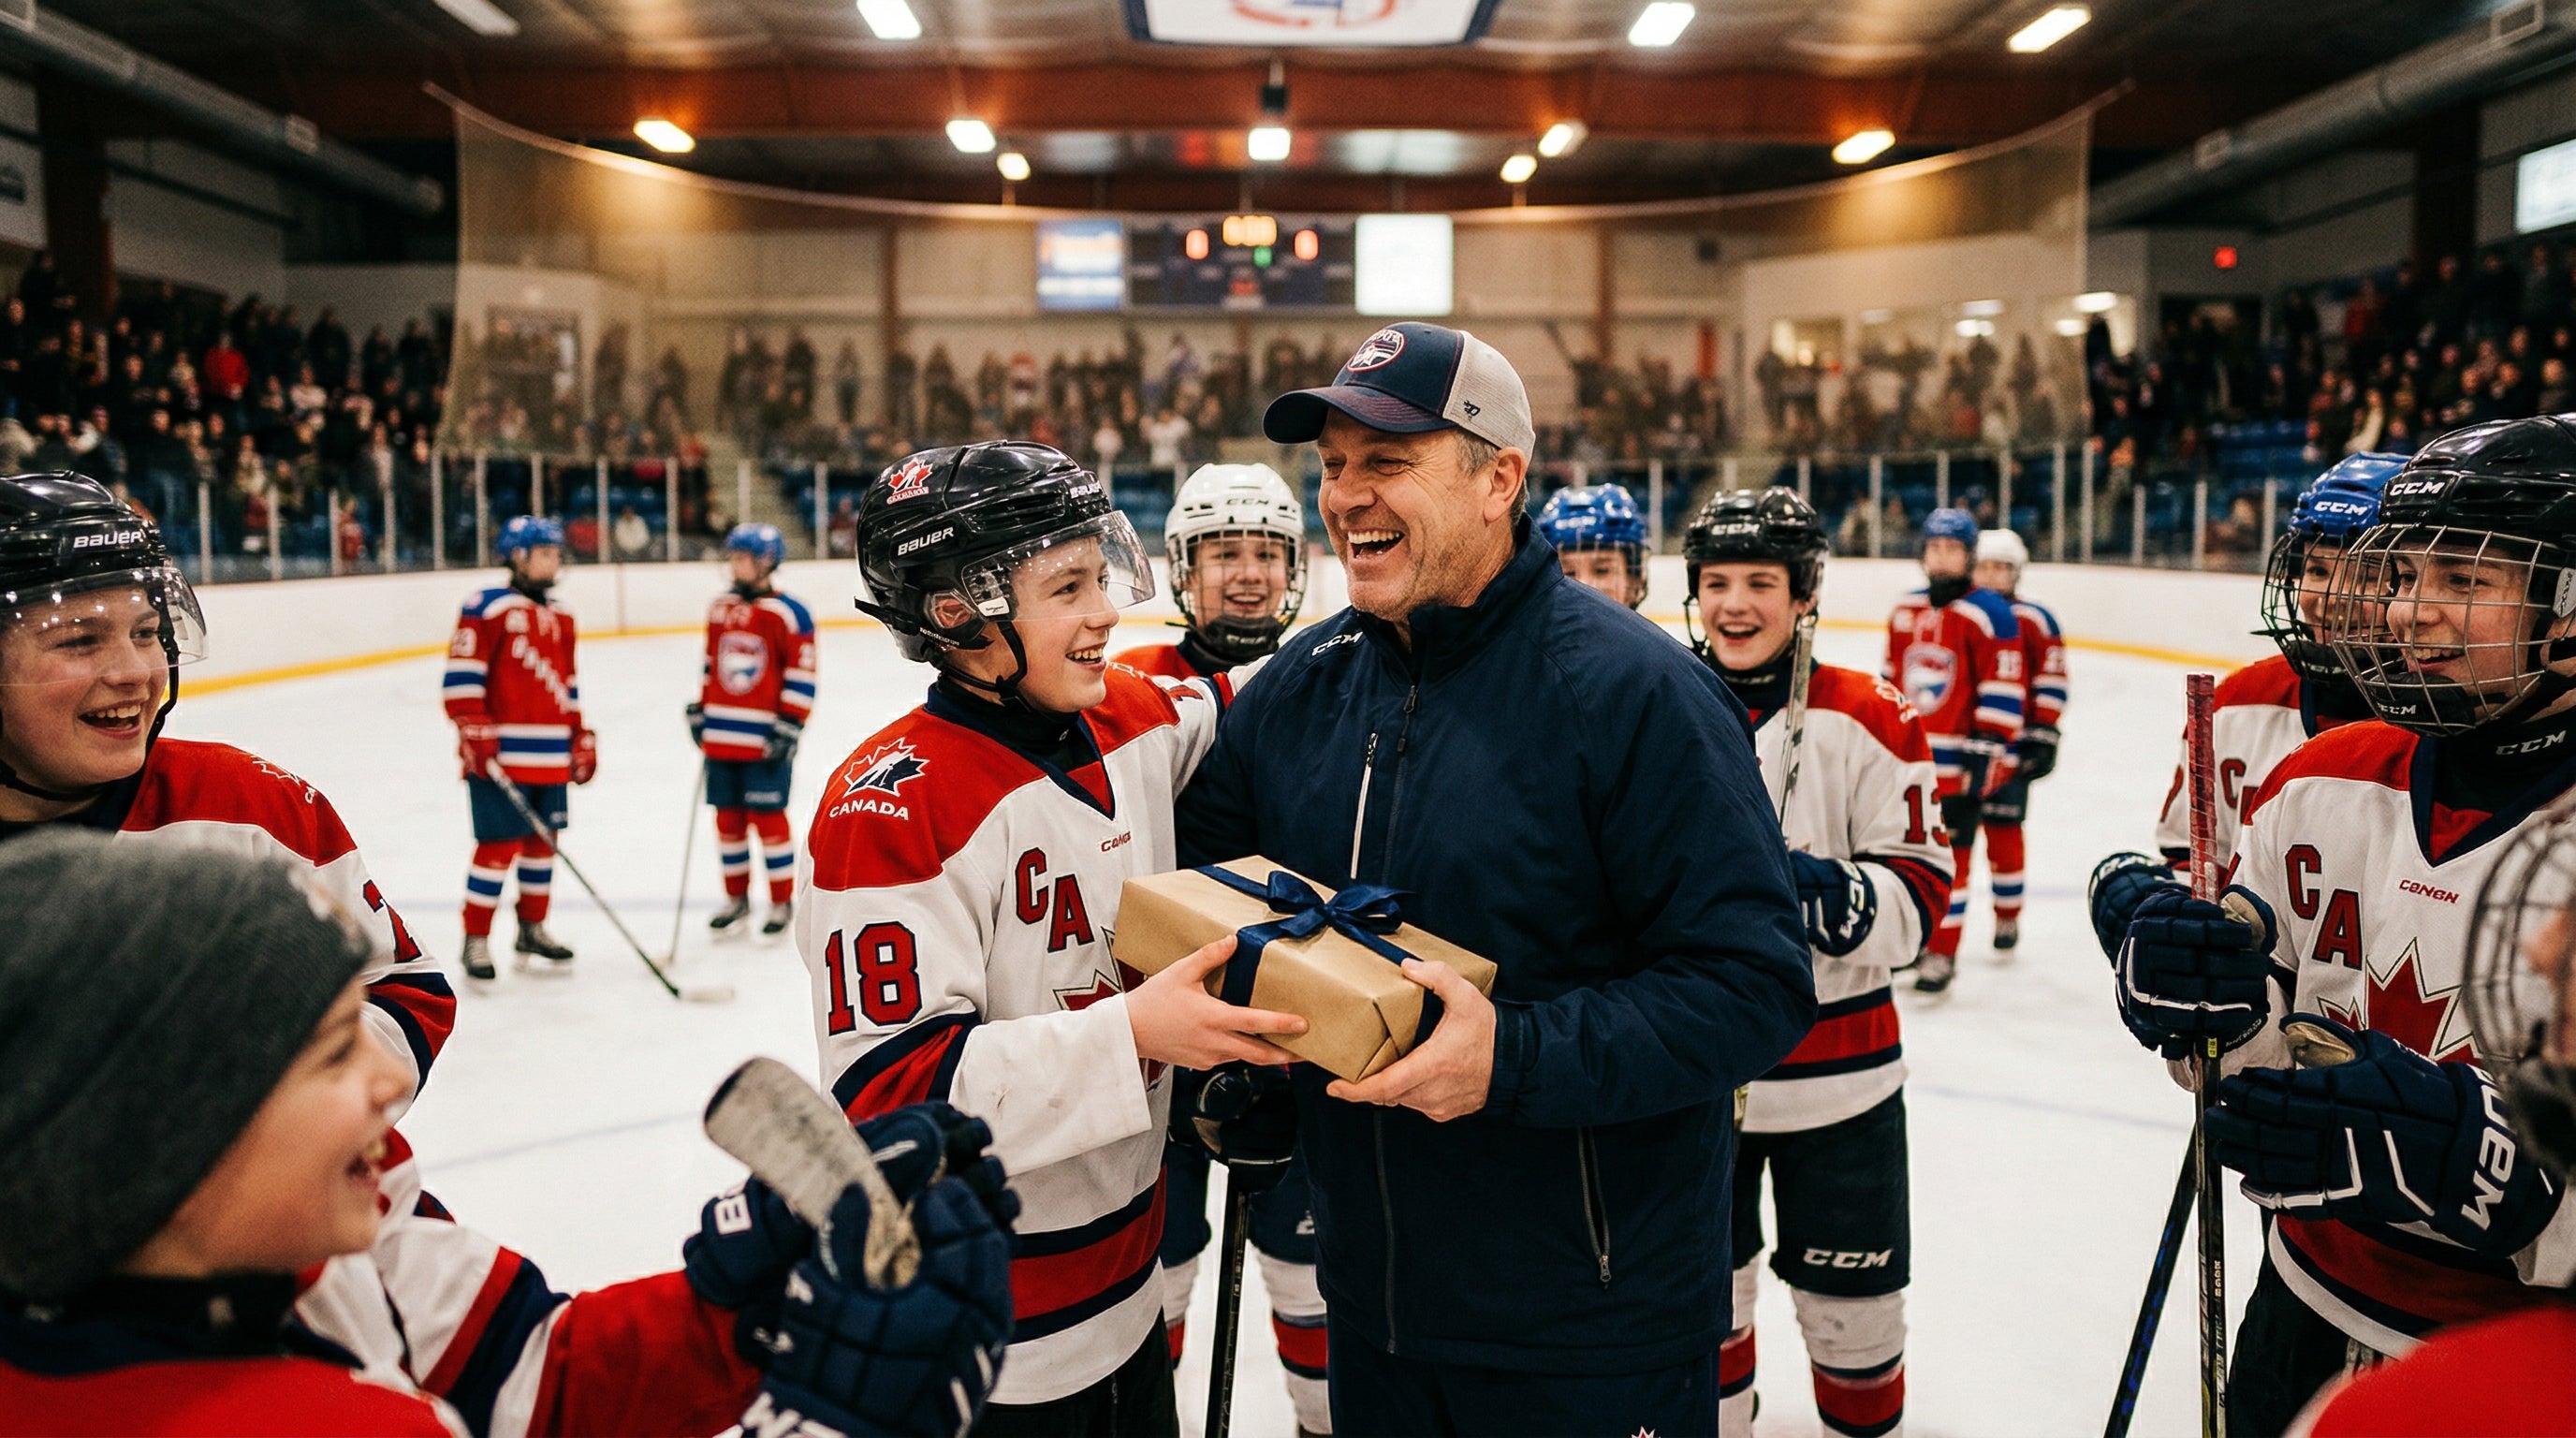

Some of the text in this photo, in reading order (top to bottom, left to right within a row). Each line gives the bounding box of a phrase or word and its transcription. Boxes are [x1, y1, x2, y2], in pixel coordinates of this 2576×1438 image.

[2389, 481, 2446, 496] CCM
[2313, 501, 2368, 516] CCM
[73, 531, 144, 549] BAUER
[898, 526, 955, 556] BAUER
[2496, 730, 2567, 756] CCM
[828, 799, 909, 821] CANADA
[825, 921, 923, 1036] 18
[1803, 1248, 1894, 1269] CCM
